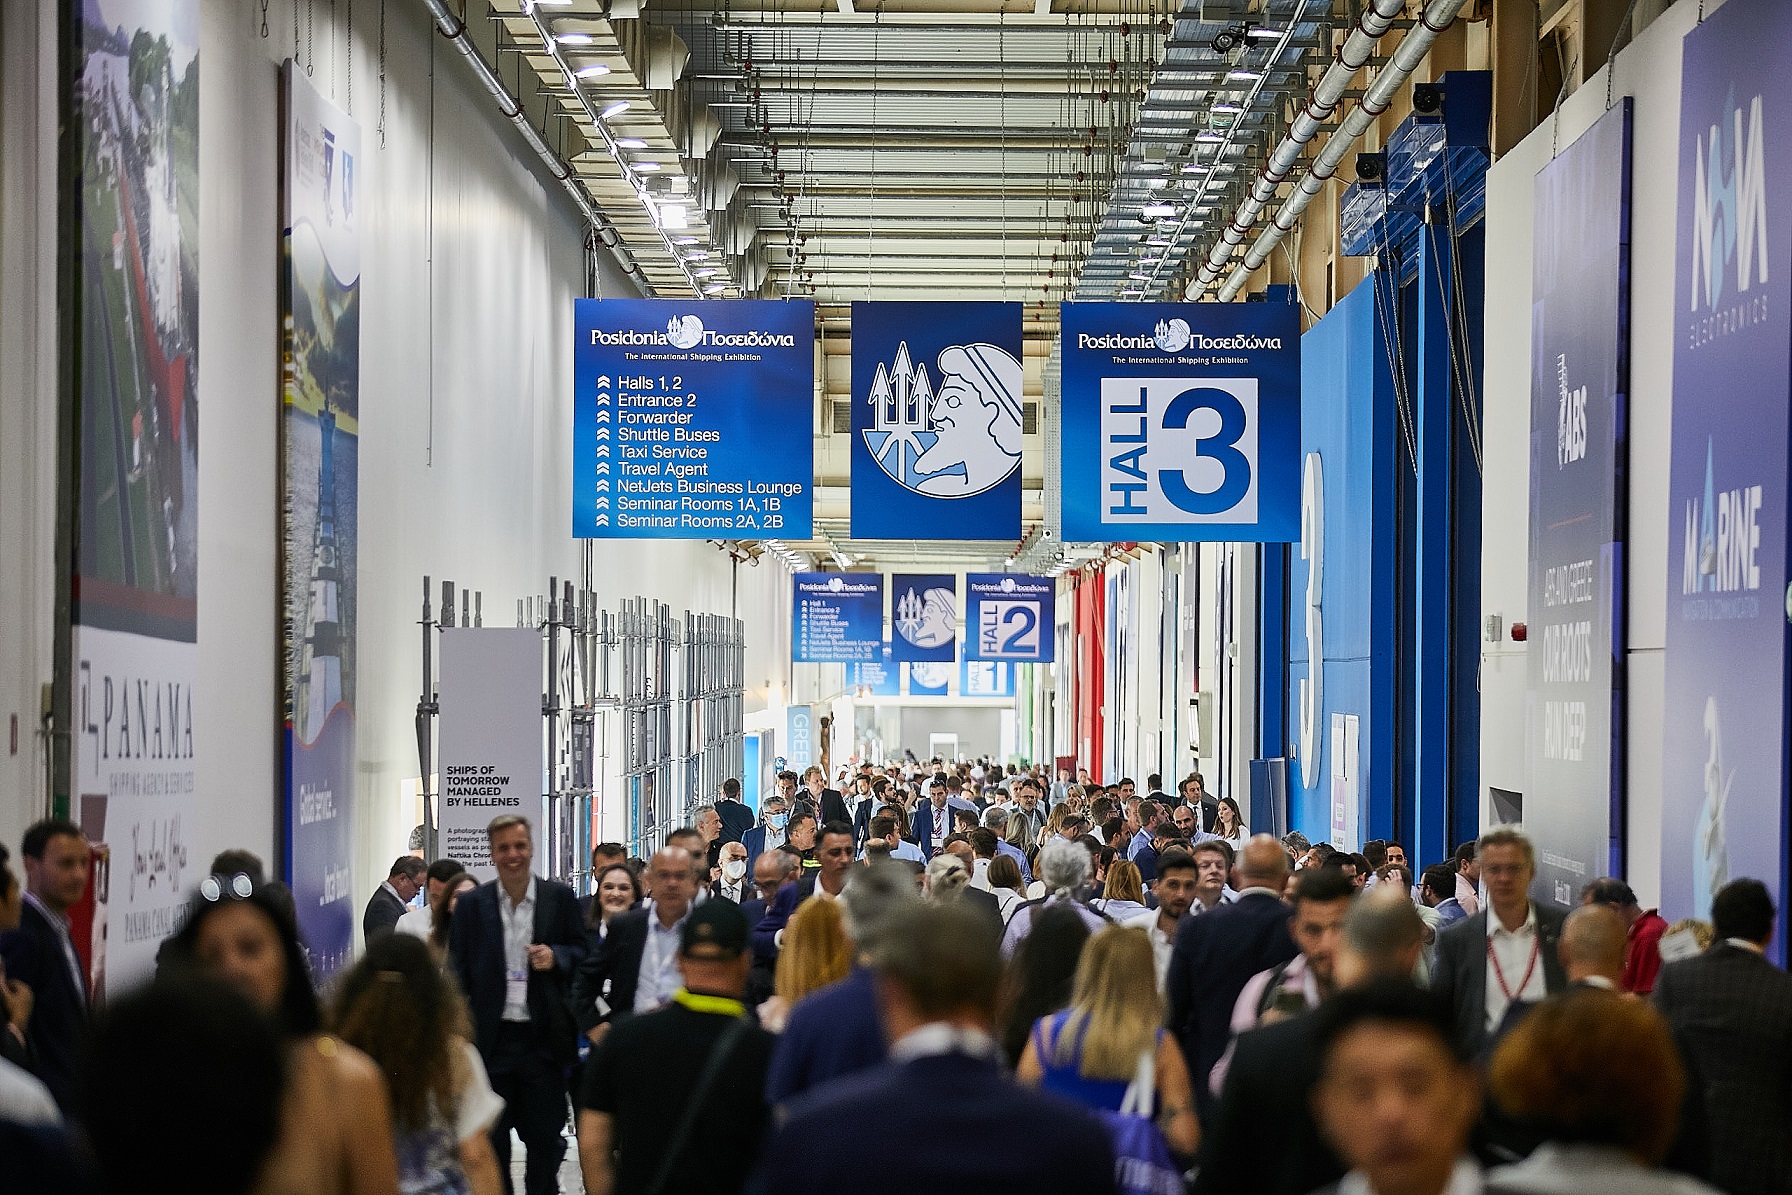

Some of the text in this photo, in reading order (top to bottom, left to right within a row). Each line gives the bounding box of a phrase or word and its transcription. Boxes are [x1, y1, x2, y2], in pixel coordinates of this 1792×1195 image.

[1690, 295, 1767, 350] ELECTRONICS
[591, 329, 669, 346] Posidonia
[702, 330, 795, 347] Ποσειδώνια
[1078, 333, 1156, 350] Posidonia
[1189, 333, 1282, 350] Ποσειδώνια
[625, 352, 761, 362] The International Shipping Exhibition
[1112, 356, 1249, 366] The International Shipping Exhibition
[617, 375, 654, 390] Halls
[617, 393, 697, 408] Entrance 2
[617, 410, 693, 425] Forwarder
[1564, 385, 1587, 464] ABS
[617, 427, 720, 442] Shuttle Buses
[617, 445, 708, 459] Taxi Service
[1110, 387, 1148, 515] HALL
[1158, 387, 1251, 515] 3
[617, 462, 709, 479] Travel Agent
[617, 479, 802, 497] NetJets Business Lounge
[617, 496, 679, 511] Seminar
[681, 497, 734, 511] Rooms
[617, 513, 679, 528] Seminar
[681, 514, 733, 528] Rooms
[1683, 440, 1762, 595] MARINE
[1569, 560, 1593, 604] GREECE
[983, 604, 998, 653] HALL
[1001, 606, 1036, 653] 2
[1543, 621, 1591, 683] OUR ROOTS
[103, 676, 193, 759] PANAMA
[1545, 701, 1586, 760] RUN DEEP
[447, 766, 495, 775] SHIPS OF
[447, 776, 510, 785] TOMORROW
[447, 787, 501, 796] MANAGED
[447, 797, 520, 806] BY HELLENES
